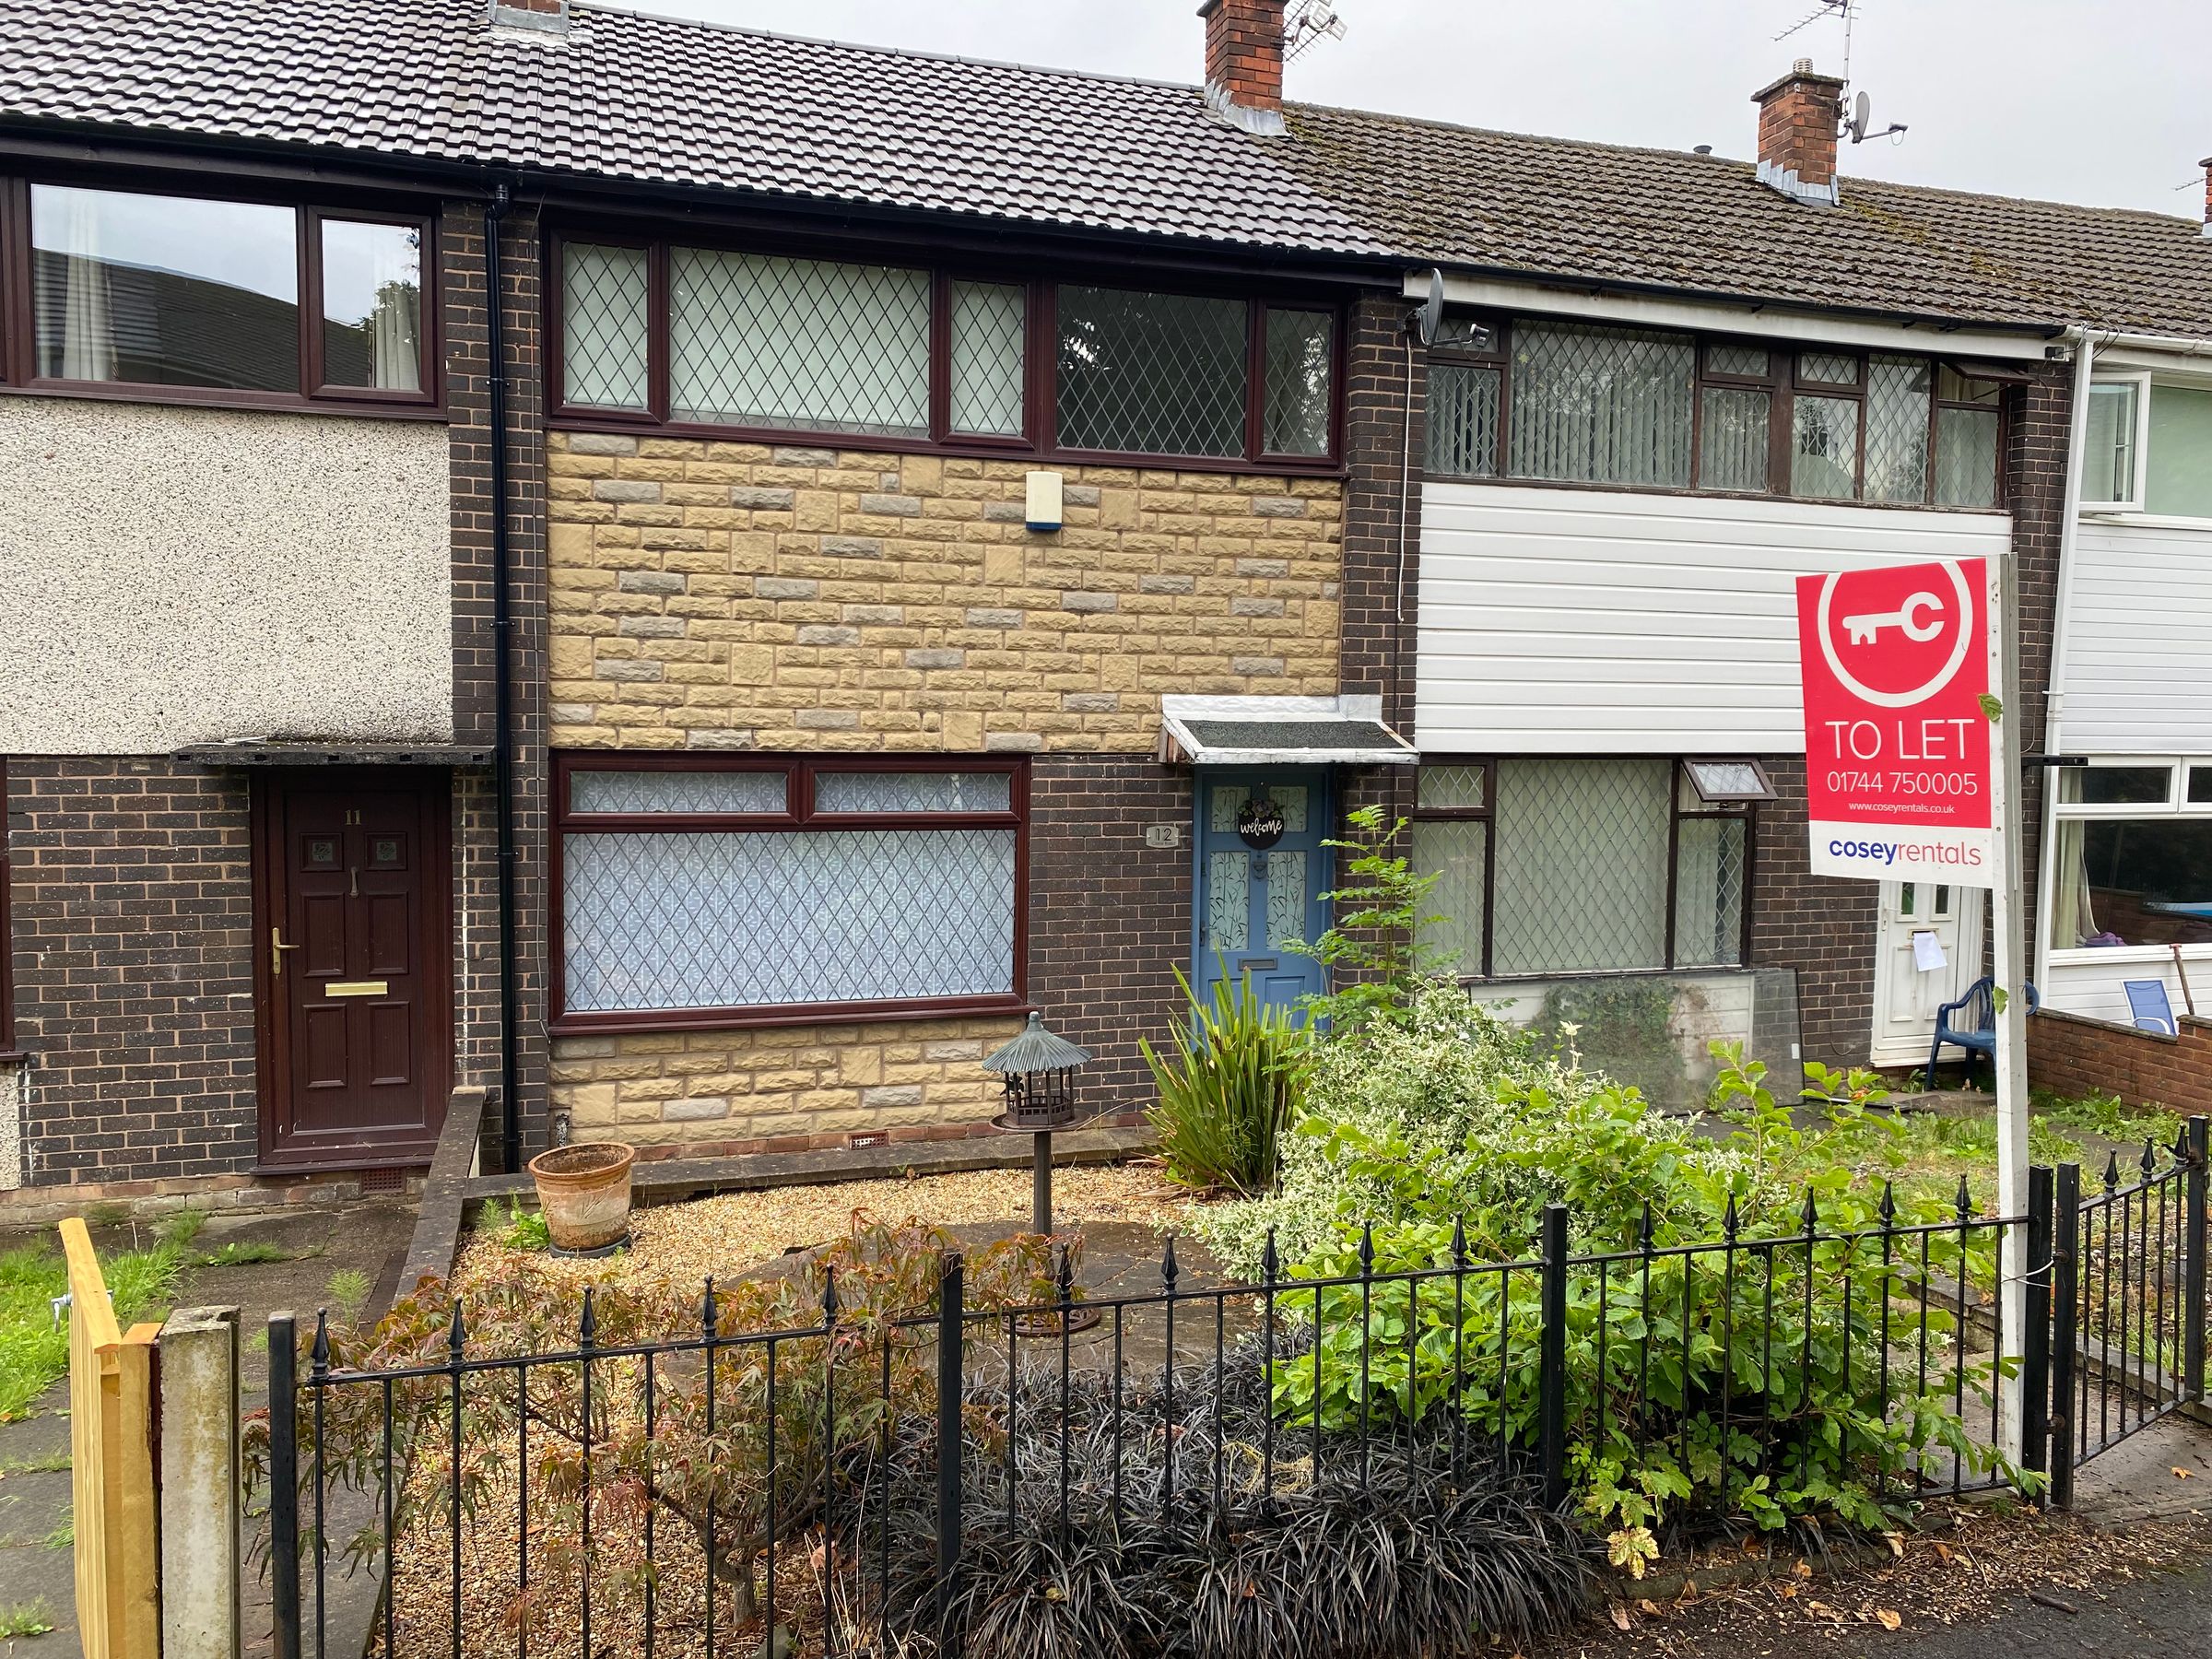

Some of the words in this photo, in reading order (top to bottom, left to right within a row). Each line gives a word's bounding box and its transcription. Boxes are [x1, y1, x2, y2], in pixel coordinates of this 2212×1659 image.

[1825, 720, 1882, 760] TO
[1898, 718, 1975, 760] LET
[1827, 771, 1884, 793] 01744
[1890, 771, 1978, 795] 750005
[345, 809, 361, 826] 11
[1849, 801, 1955, 815] www.coseyrentals.co.uk
[1156, 828, 1172, 841] 12
[1240, 817, 1283, 837] welcome
[1830, 840, 1982, 865] coseyrentals
